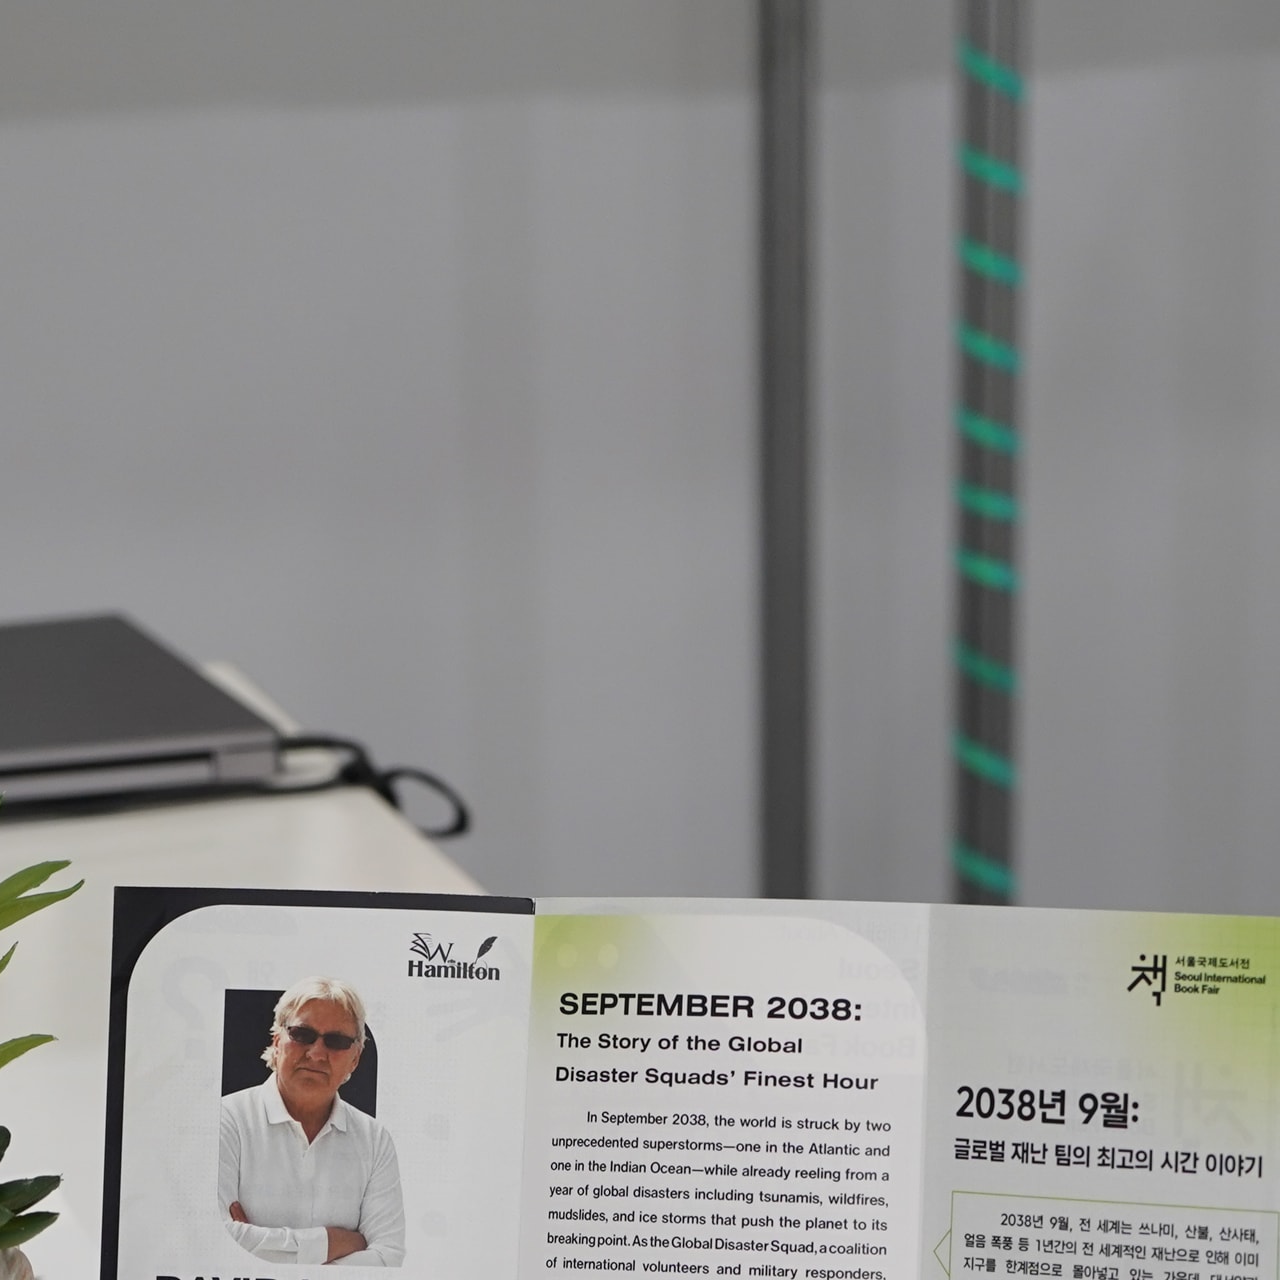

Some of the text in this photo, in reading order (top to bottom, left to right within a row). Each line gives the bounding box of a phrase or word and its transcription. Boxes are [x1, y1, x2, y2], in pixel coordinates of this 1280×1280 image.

[408, 960, 500, 981] Hamilton
[1175, 955, 1251, 970] 서울국제도서전
[1174, 971, 1266, 985] Seoul International
[1174, 983, 1221, 995] Book Fair
[559, 992, 862, 1022] SEPTEMBER 2038:
[556, 1032, 803, 1054] The Story of the Global
[555, 1066, 879, 1090] Disaster Squads’ Finest Hour
[955, 1085, 1139, 1130] 2038년 9월:
[586, 1110, 892, 1134] In September 2038, the world is struck by two
[954, 1137, 1263, 1179] 글로벌 재난 팀의 최고의 시간 이야기
[549, 1184, 889, 1208] year of global disasters including tsunamis, wildfires,
[1000, 1212, 1260, 1246] 2038년 9월, 전 세계는 쓰나미, 산불, 산사태,
